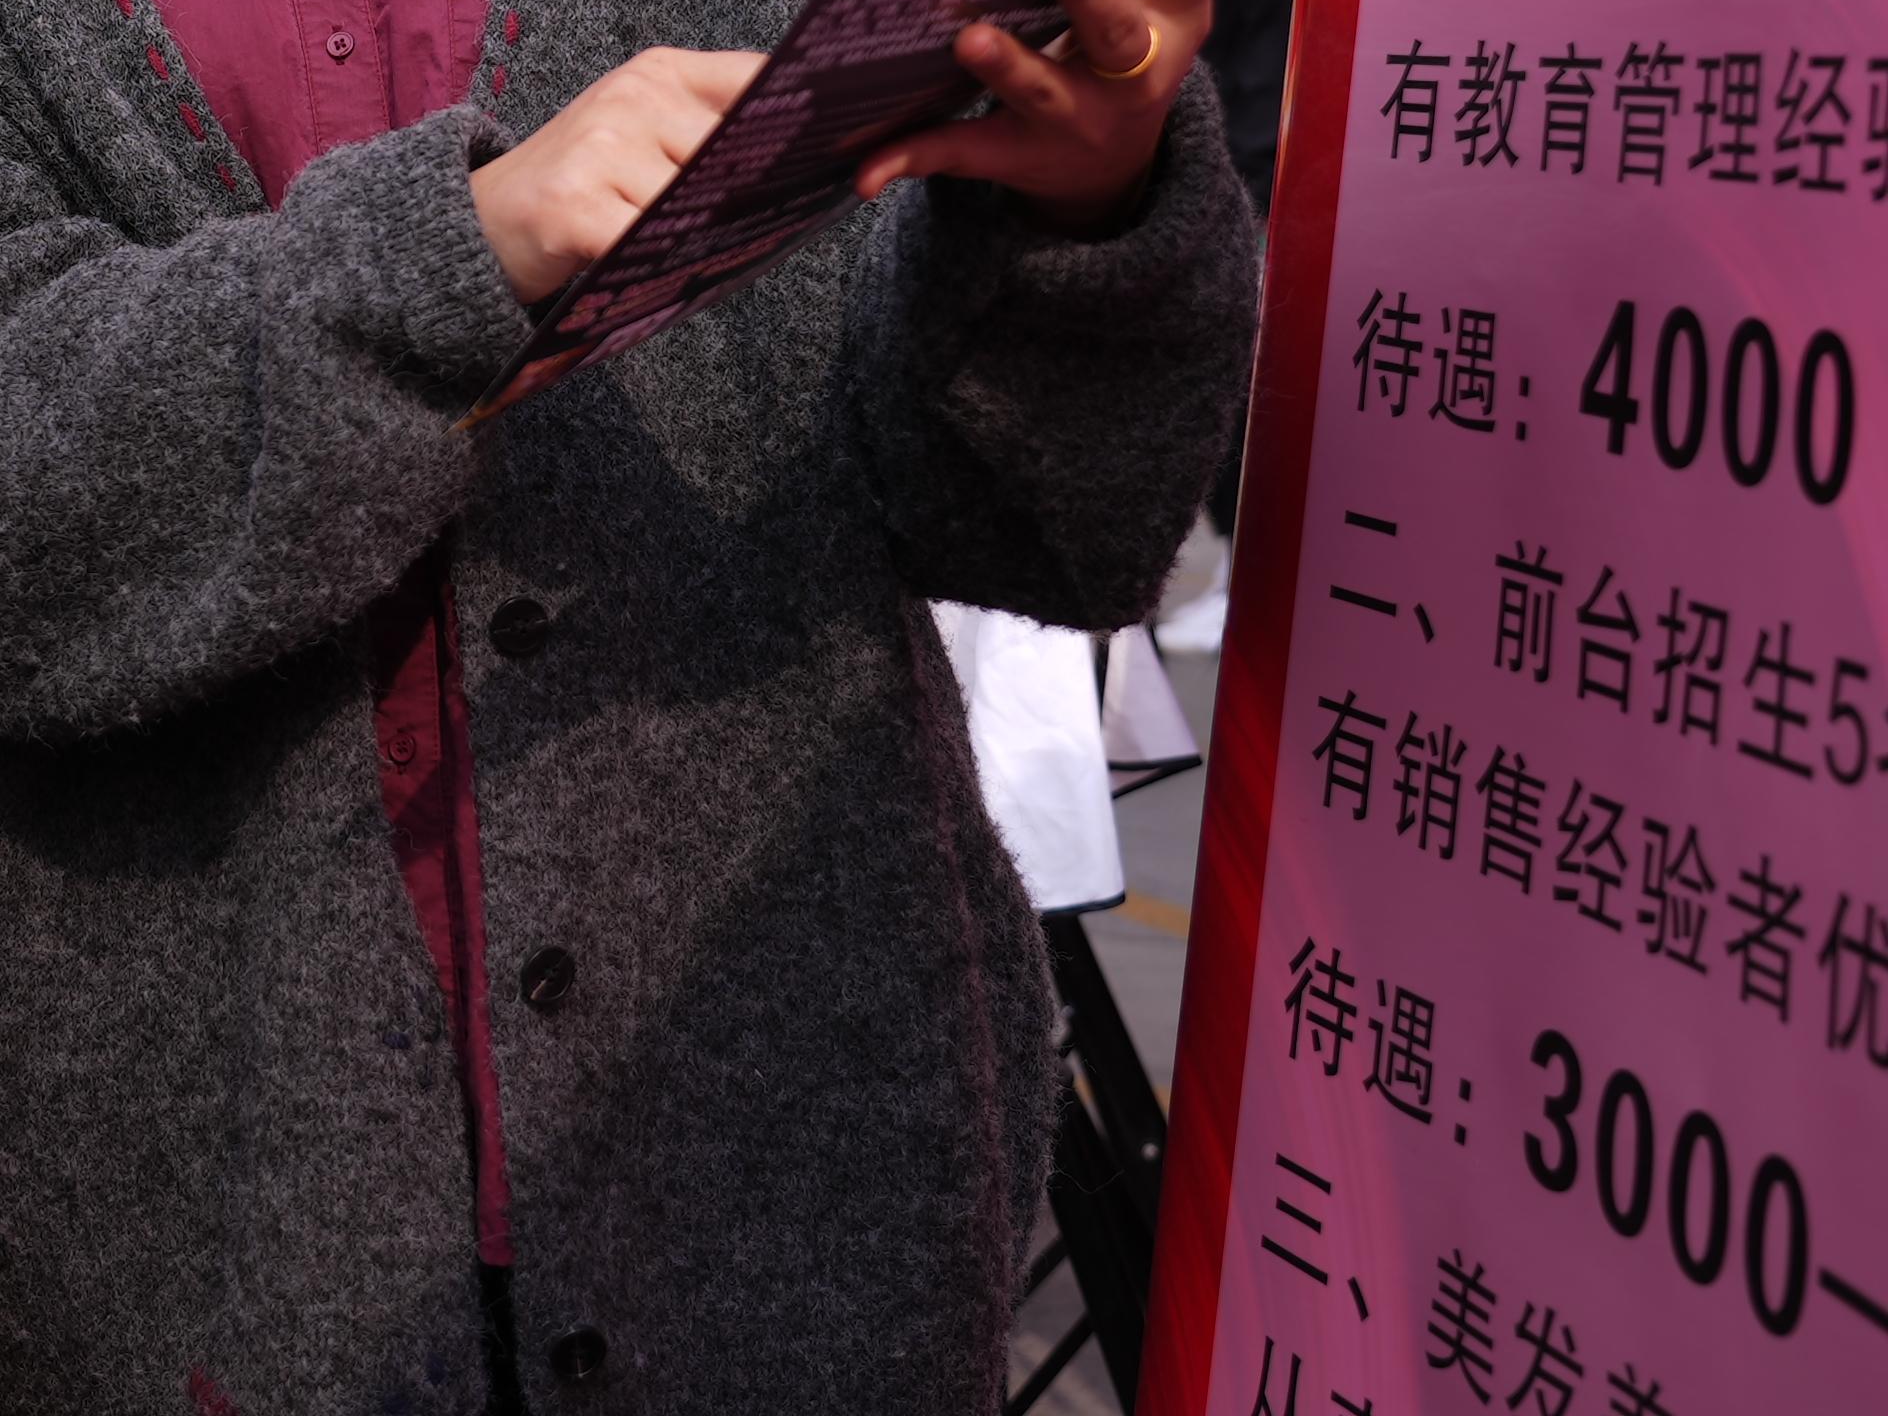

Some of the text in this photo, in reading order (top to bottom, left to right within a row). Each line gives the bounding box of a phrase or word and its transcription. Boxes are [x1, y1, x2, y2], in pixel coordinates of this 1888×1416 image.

[1329, 509, 1888, 789] 二、前台招生5
[1311, 689, 1888, 1071] 有销售经验者优
